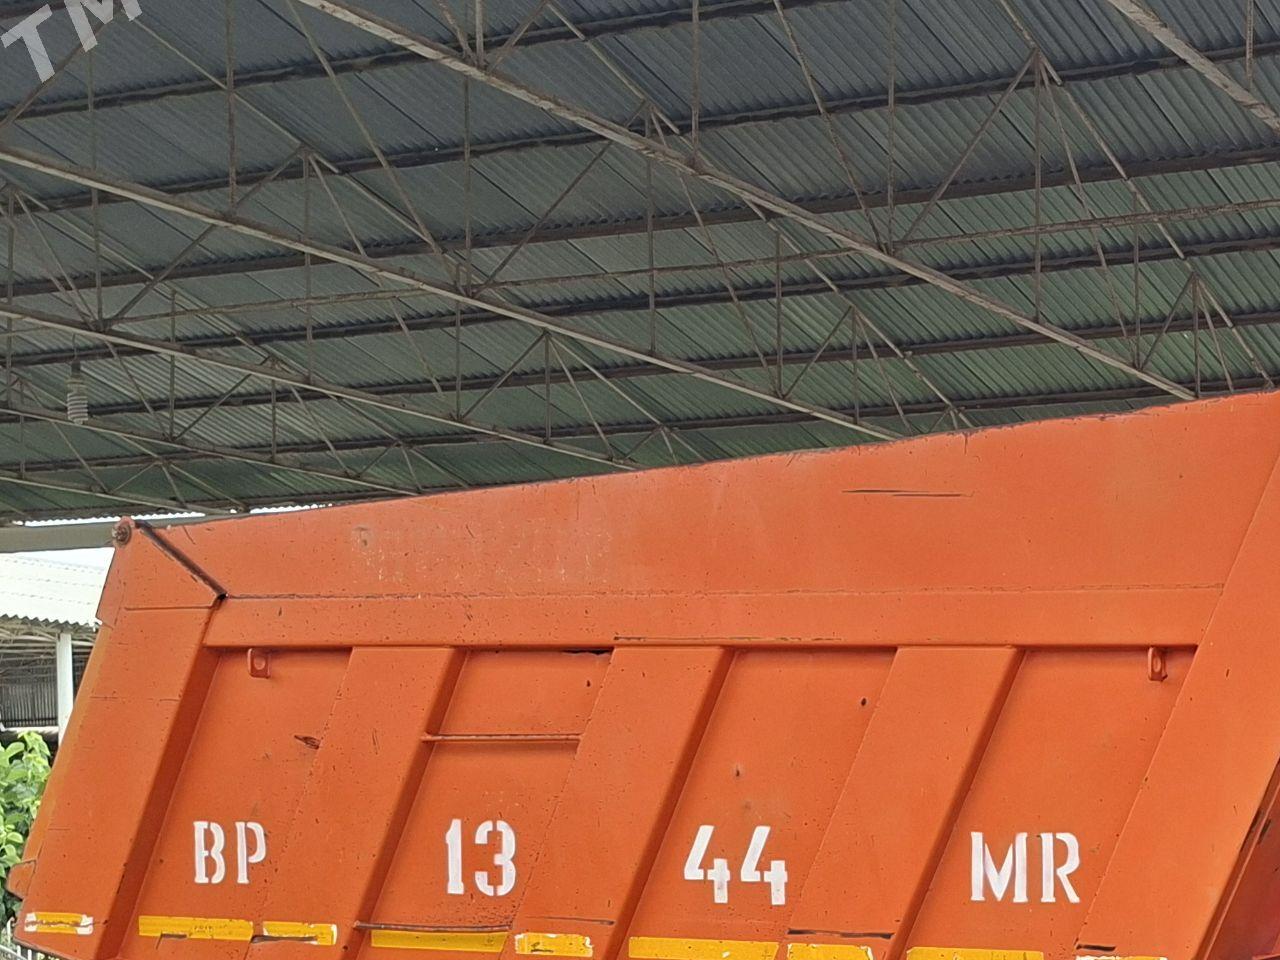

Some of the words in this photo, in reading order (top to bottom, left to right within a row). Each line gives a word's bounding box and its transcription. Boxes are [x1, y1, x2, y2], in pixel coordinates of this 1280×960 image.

[193, 821, 267, 884] BP
[445, 818, 516, 897] 13
[684, 825, 788, 905] 44
[970, 831, 1081, 903] MR
